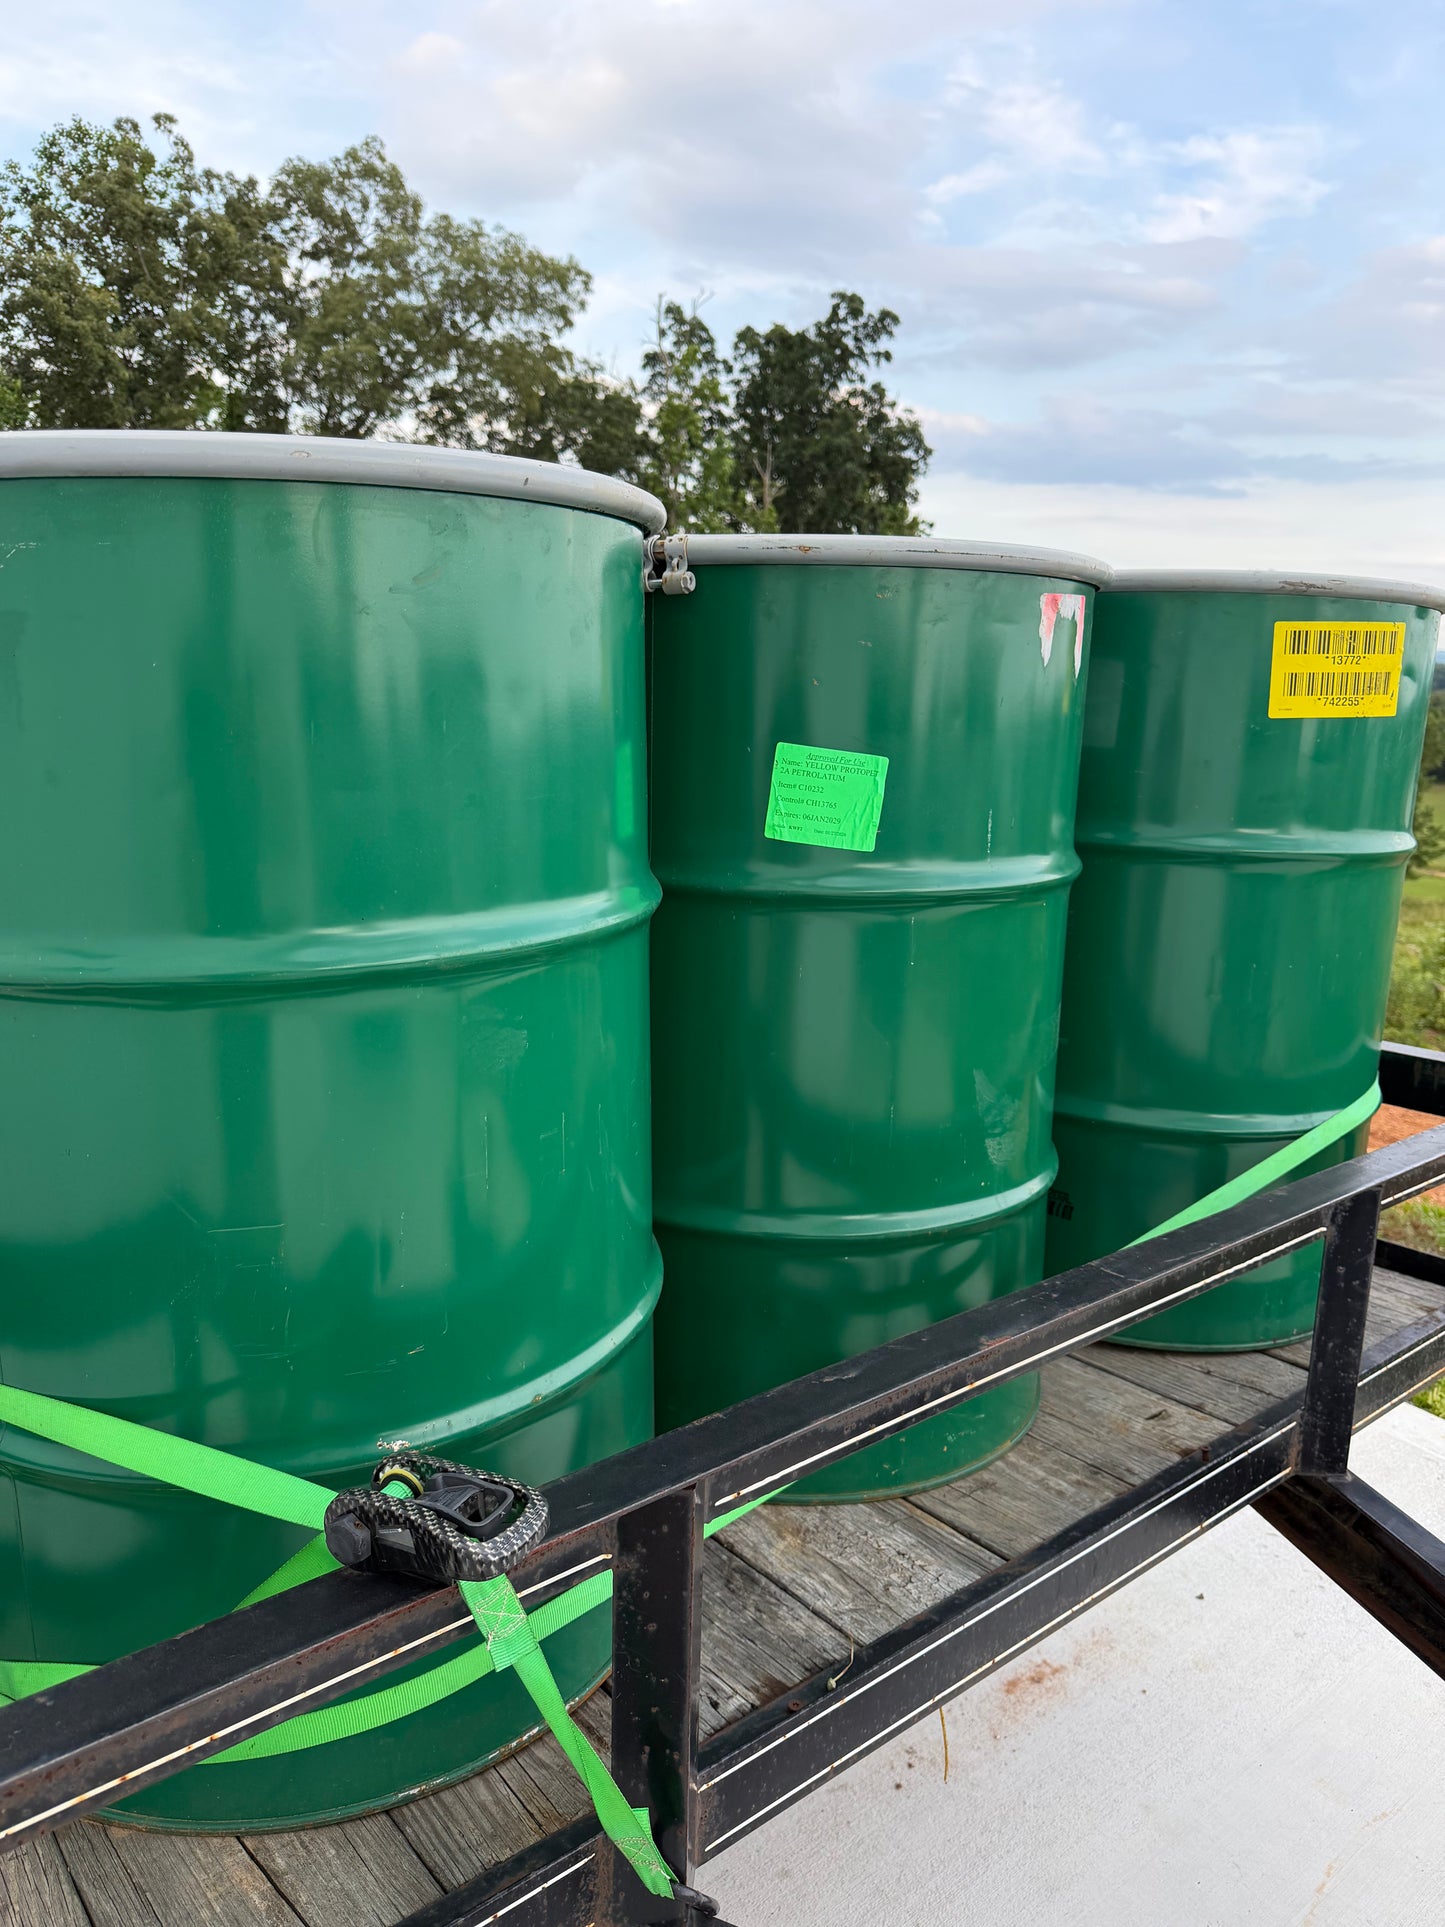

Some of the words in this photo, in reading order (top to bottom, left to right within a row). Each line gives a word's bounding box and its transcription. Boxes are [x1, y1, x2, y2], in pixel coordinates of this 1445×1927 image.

[781, 757, 803, 767] Name:
[805, 760, 839, 772] YELLOW
[840, 765, 879, 777] PROTOPET
[806, 753, 839, 764] Approved
[839, 756, 852, 765] For
[853, 758, 866, 767] Use
[780, 766, 790, 775] 2A
[791, 768, 846, 783] PETROLATUM
[778, 781, 796, 790] Item#
[798, 783, 825, 794] C10232
[776, 794, 805, 805] Control#
[805, 798, 838, 810] CH13765
[775, 809, 801, 820] Expires:
[802, 814, 842, 825] 06JAN2029
